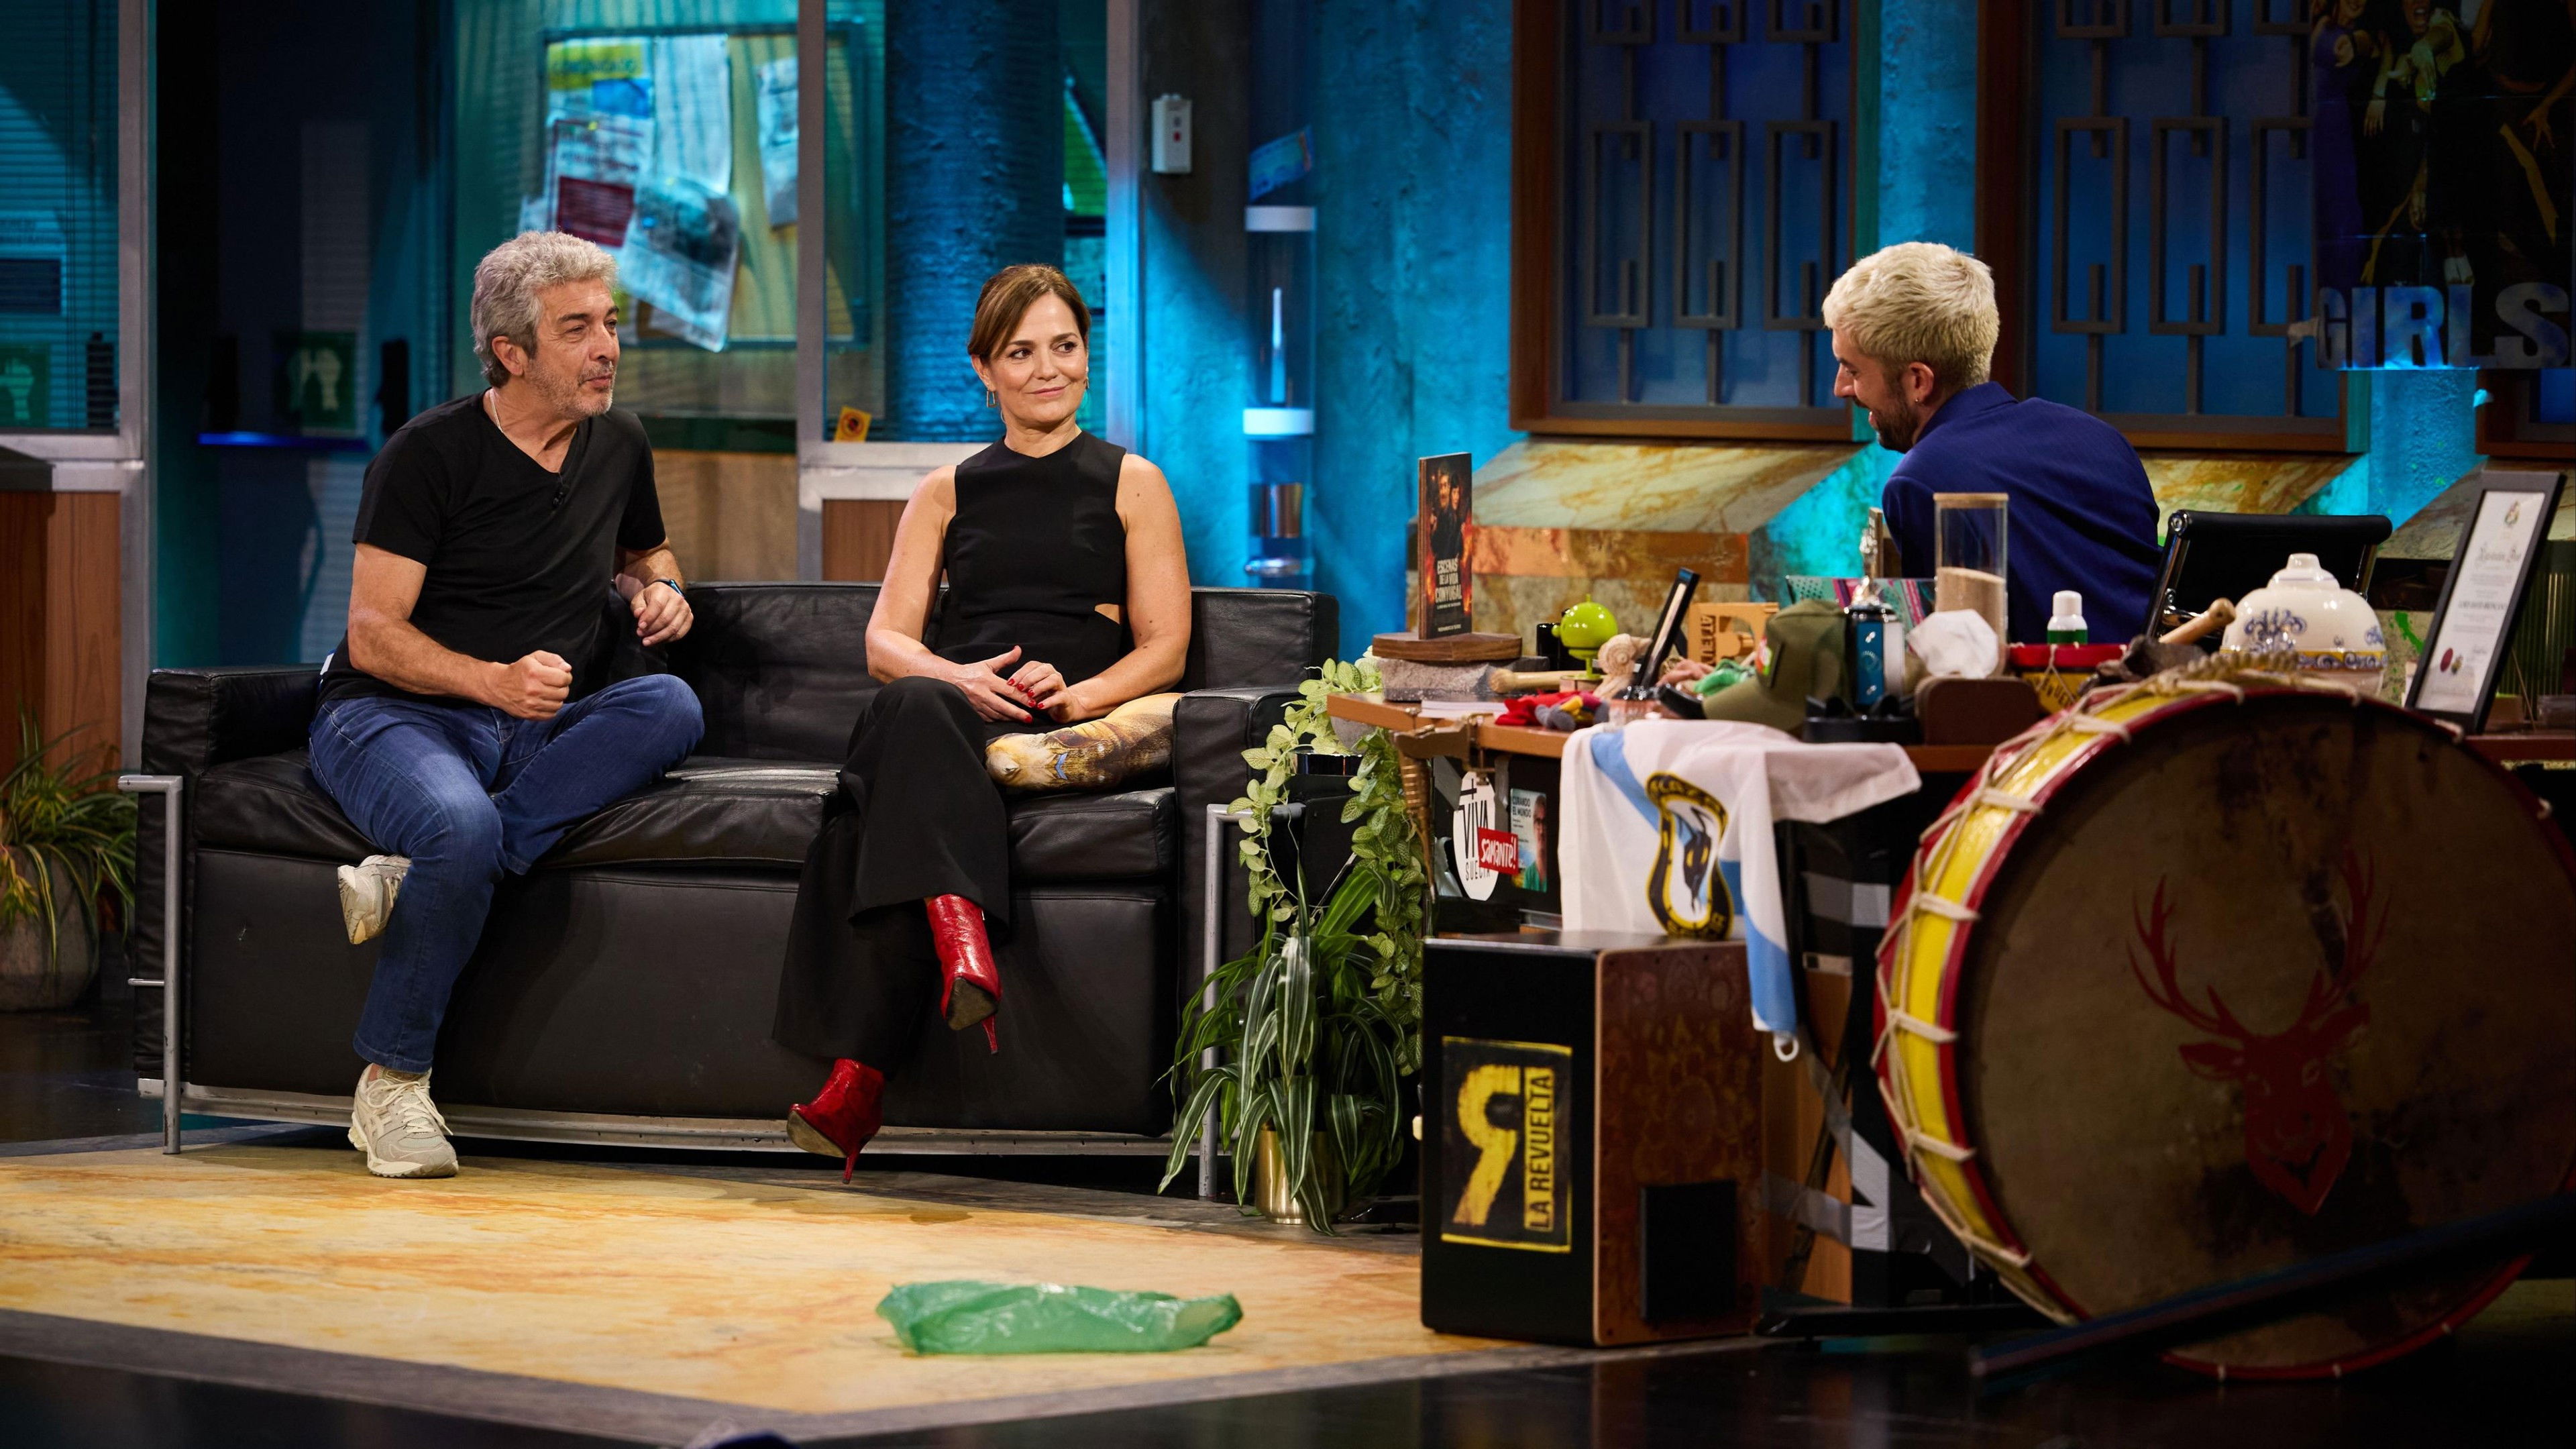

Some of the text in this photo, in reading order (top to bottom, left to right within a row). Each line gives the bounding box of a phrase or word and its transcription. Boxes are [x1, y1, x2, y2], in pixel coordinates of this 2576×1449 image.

[2318, 282, 2570, 369] GIRLS
[1437, 558, 1458, 574] ESCENAS
[1530, 1075, 1552, 1228] LA REVUELTA
